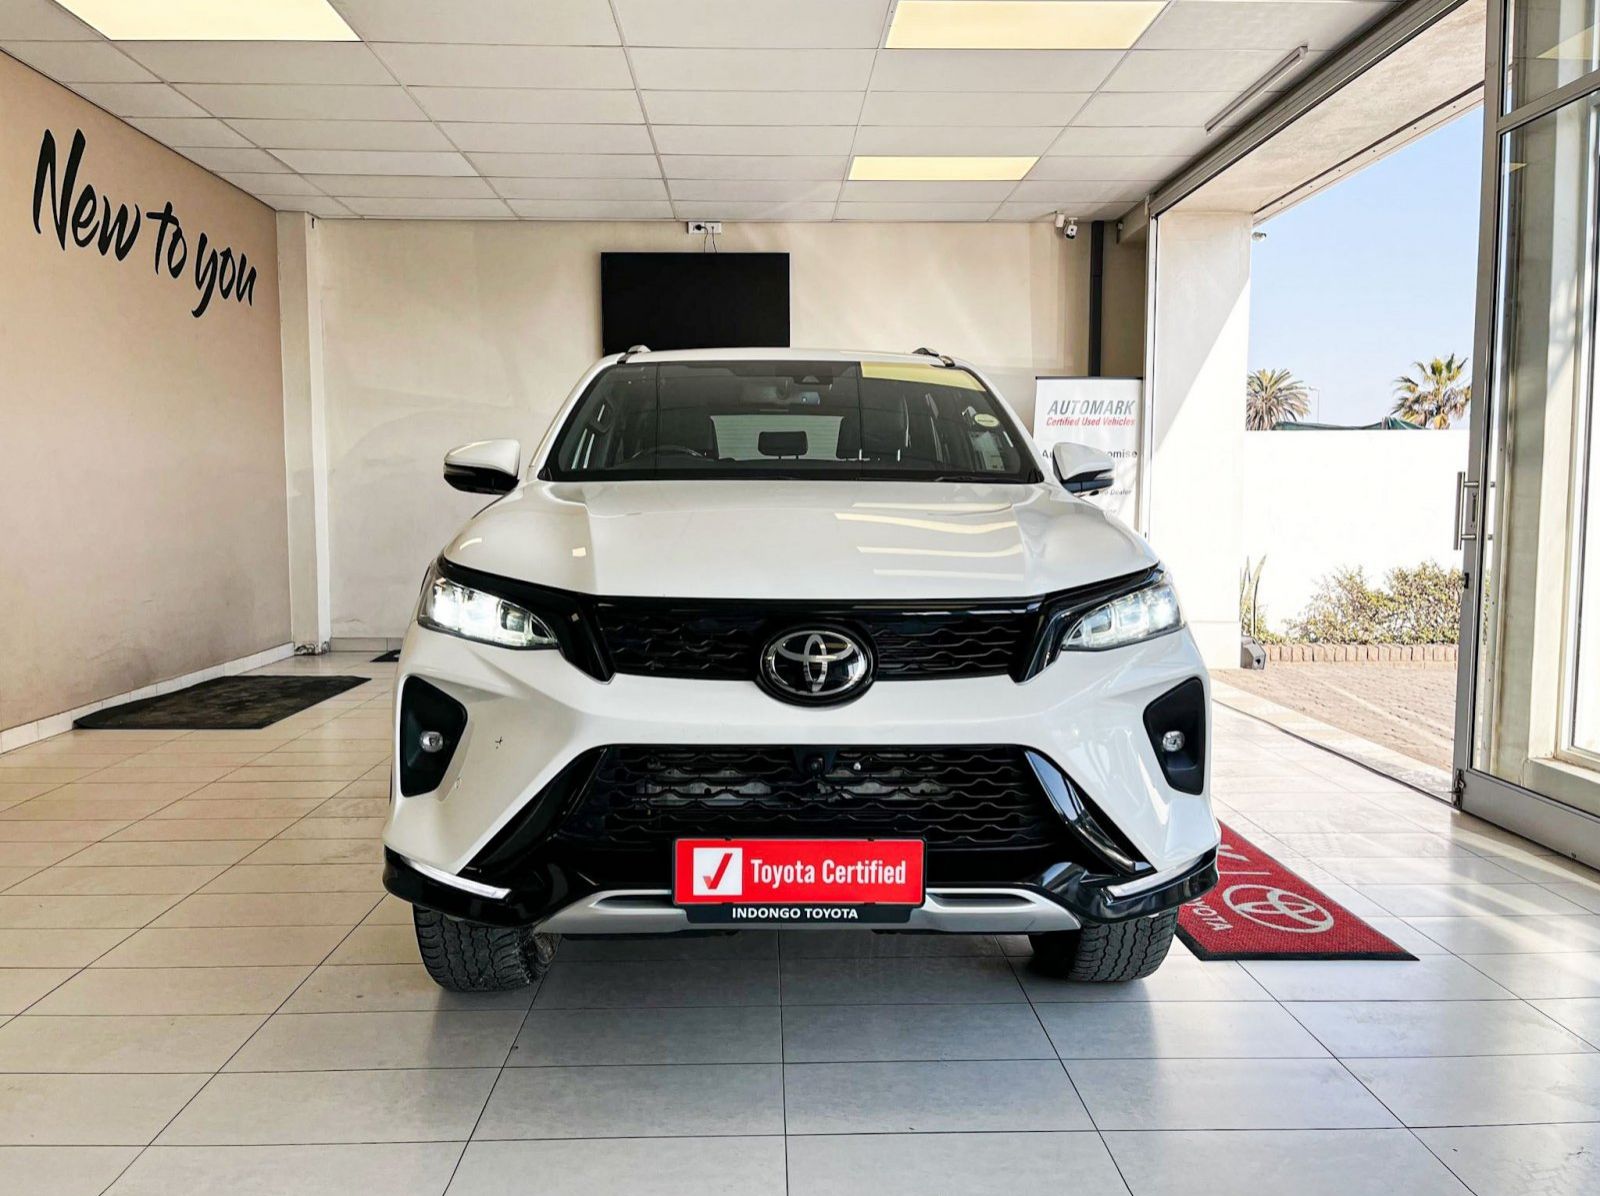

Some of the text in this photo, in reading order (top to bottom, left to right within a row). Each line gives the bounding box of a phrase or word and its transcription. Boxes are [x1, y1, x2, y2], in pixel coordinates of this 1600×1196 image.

[32, 128, 257, 319] New to you
[1047, 400, 1136, 415] AUTOMARK
[1046, 417, 1136, 427] Certified Used Vehicles
[750, 859, 907, 889] Toyota Certified
[732, 907, 859, 919] INDONGO TOYOTA
